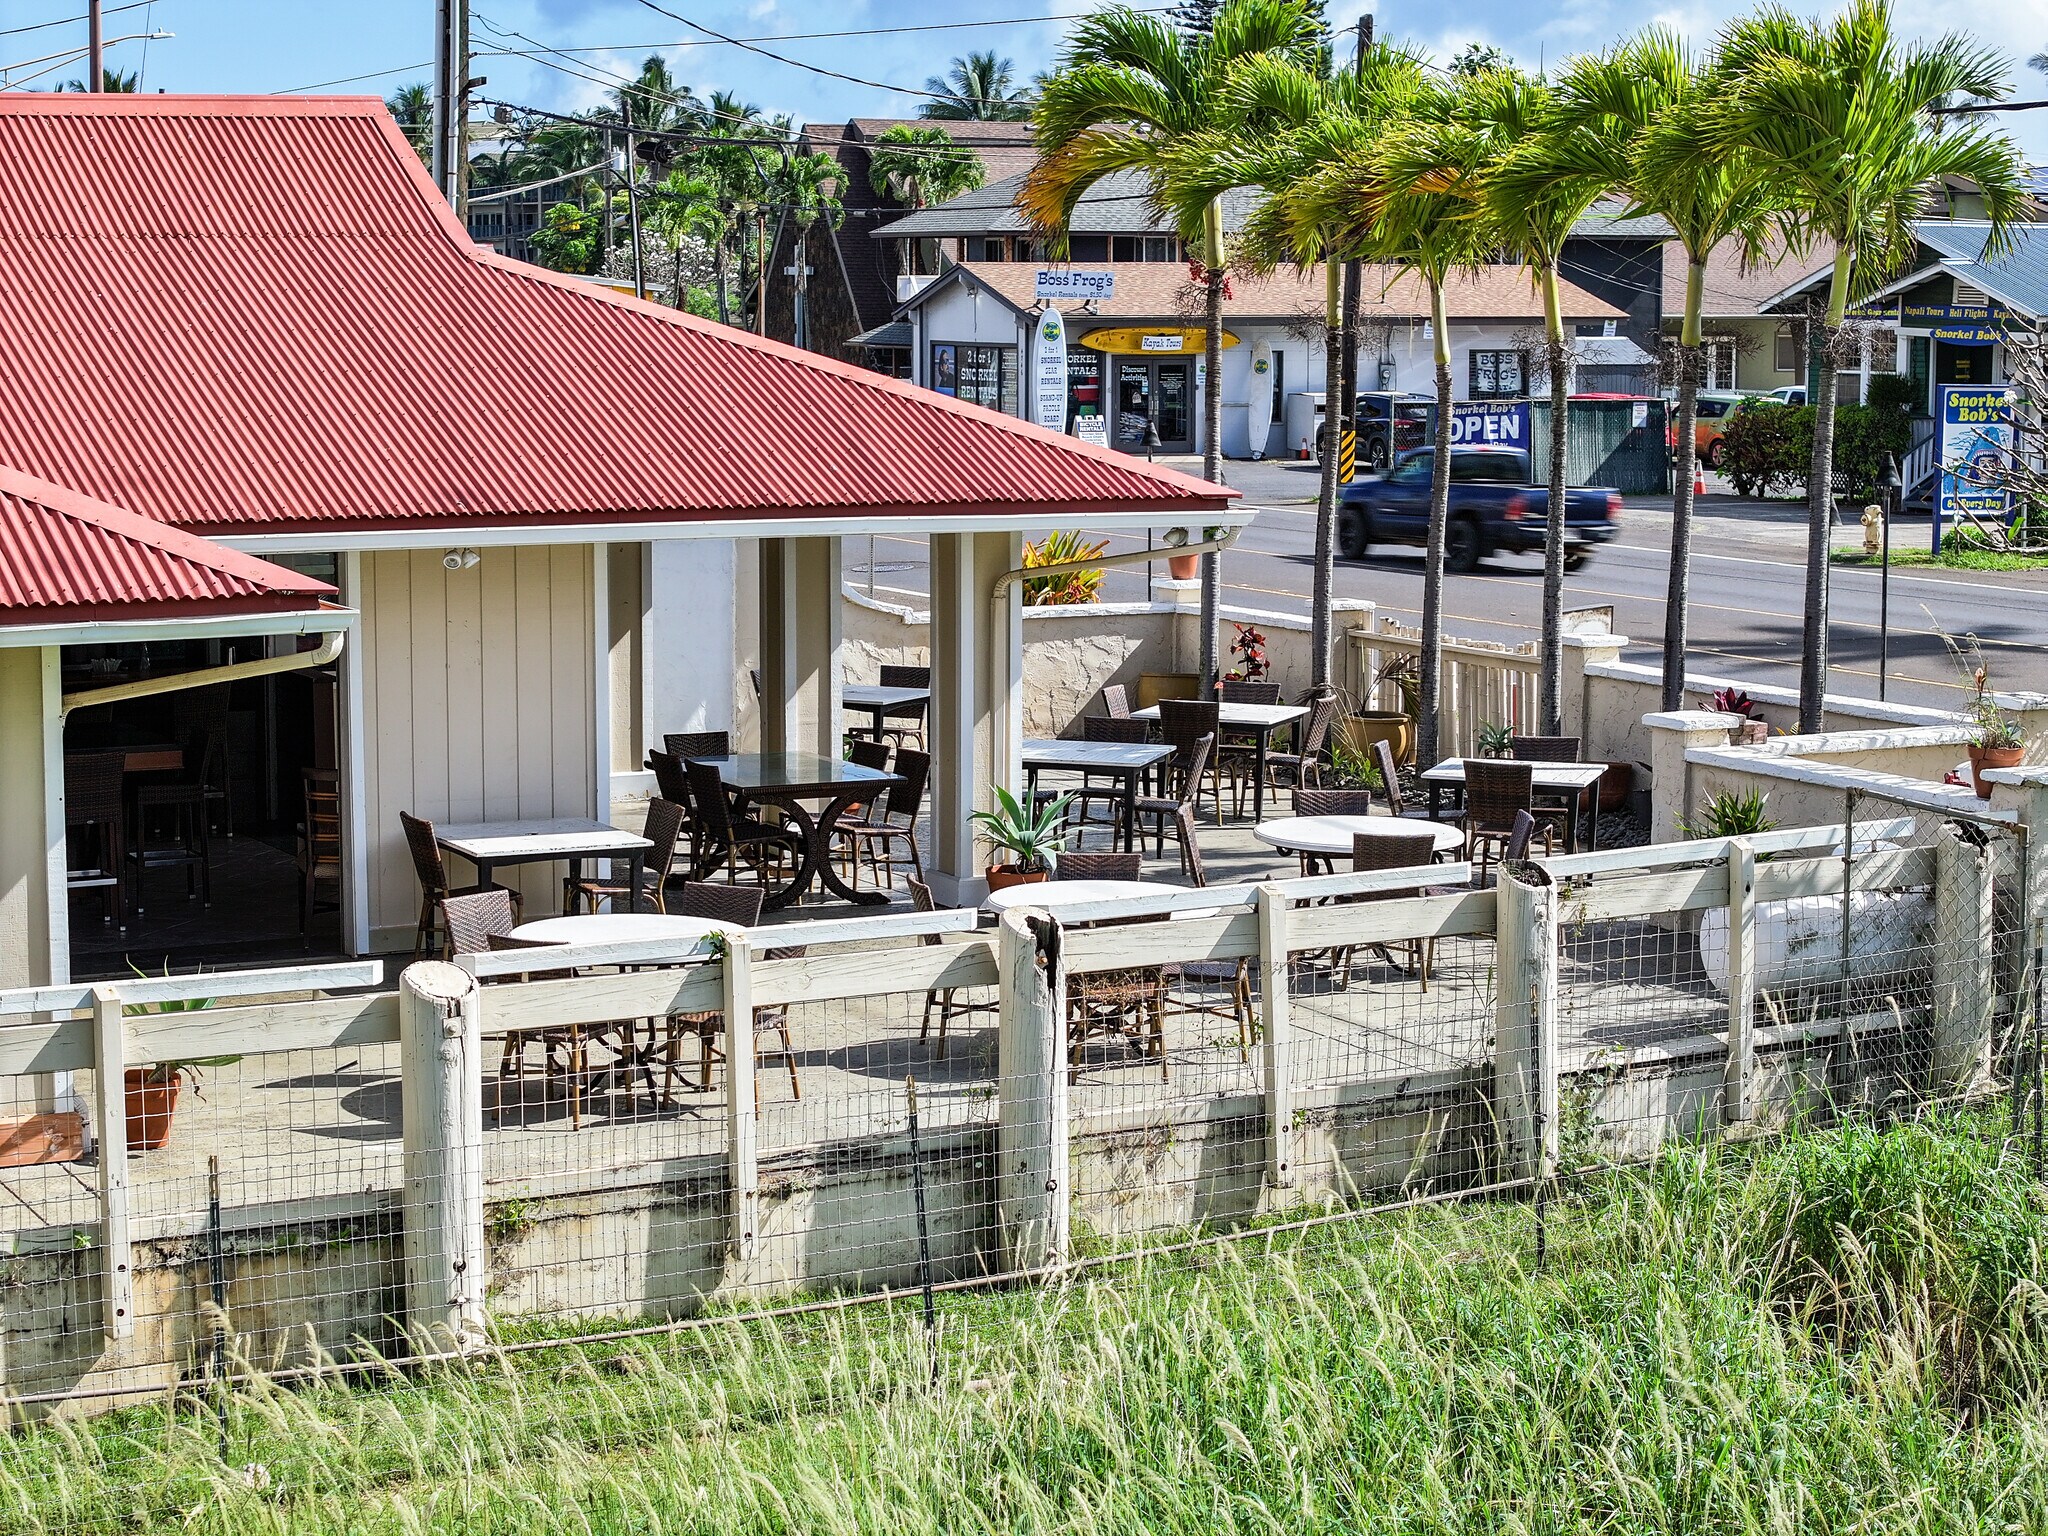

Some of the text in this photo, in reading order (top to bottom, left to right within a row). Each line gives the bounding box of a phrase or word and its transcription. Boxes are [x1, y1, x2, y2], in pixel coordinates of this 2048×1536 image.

[1037, 271, 1113, 291] Boss Frog's
[1904, 306, 1944, 316] Napali Tours
[1949, 308, 1988, 319] Heli Flights
[1993, 309, 2013, 319] Kaya
[1934, 328, 2002, 340] Snorkel Bob's
[1143, 337, 1182, 349] Kayak Tours
[967, 350, 972, 363] 2
[1067, 355, 1098, 363] ORKEL
[1480, 354, 1513, 365] BOSS
[961, 367, 998, 382] SNORKEL
[1067, 366, 1098, 375] NTALS
[1121, 365, 1147, 373] Discount
[961, 385, 998, 400] RENTALS
[1949, 393, 2009, 407] Snorke
[1451, 404, 1516, 415] Snorkel Bob's
[1958, 407, 1999, 422] Bob's
[1449, 415, 1519, 442] OPEN
[1961, 498, 1984, 509] Every
[1986, 498, 2001, 509] Day
